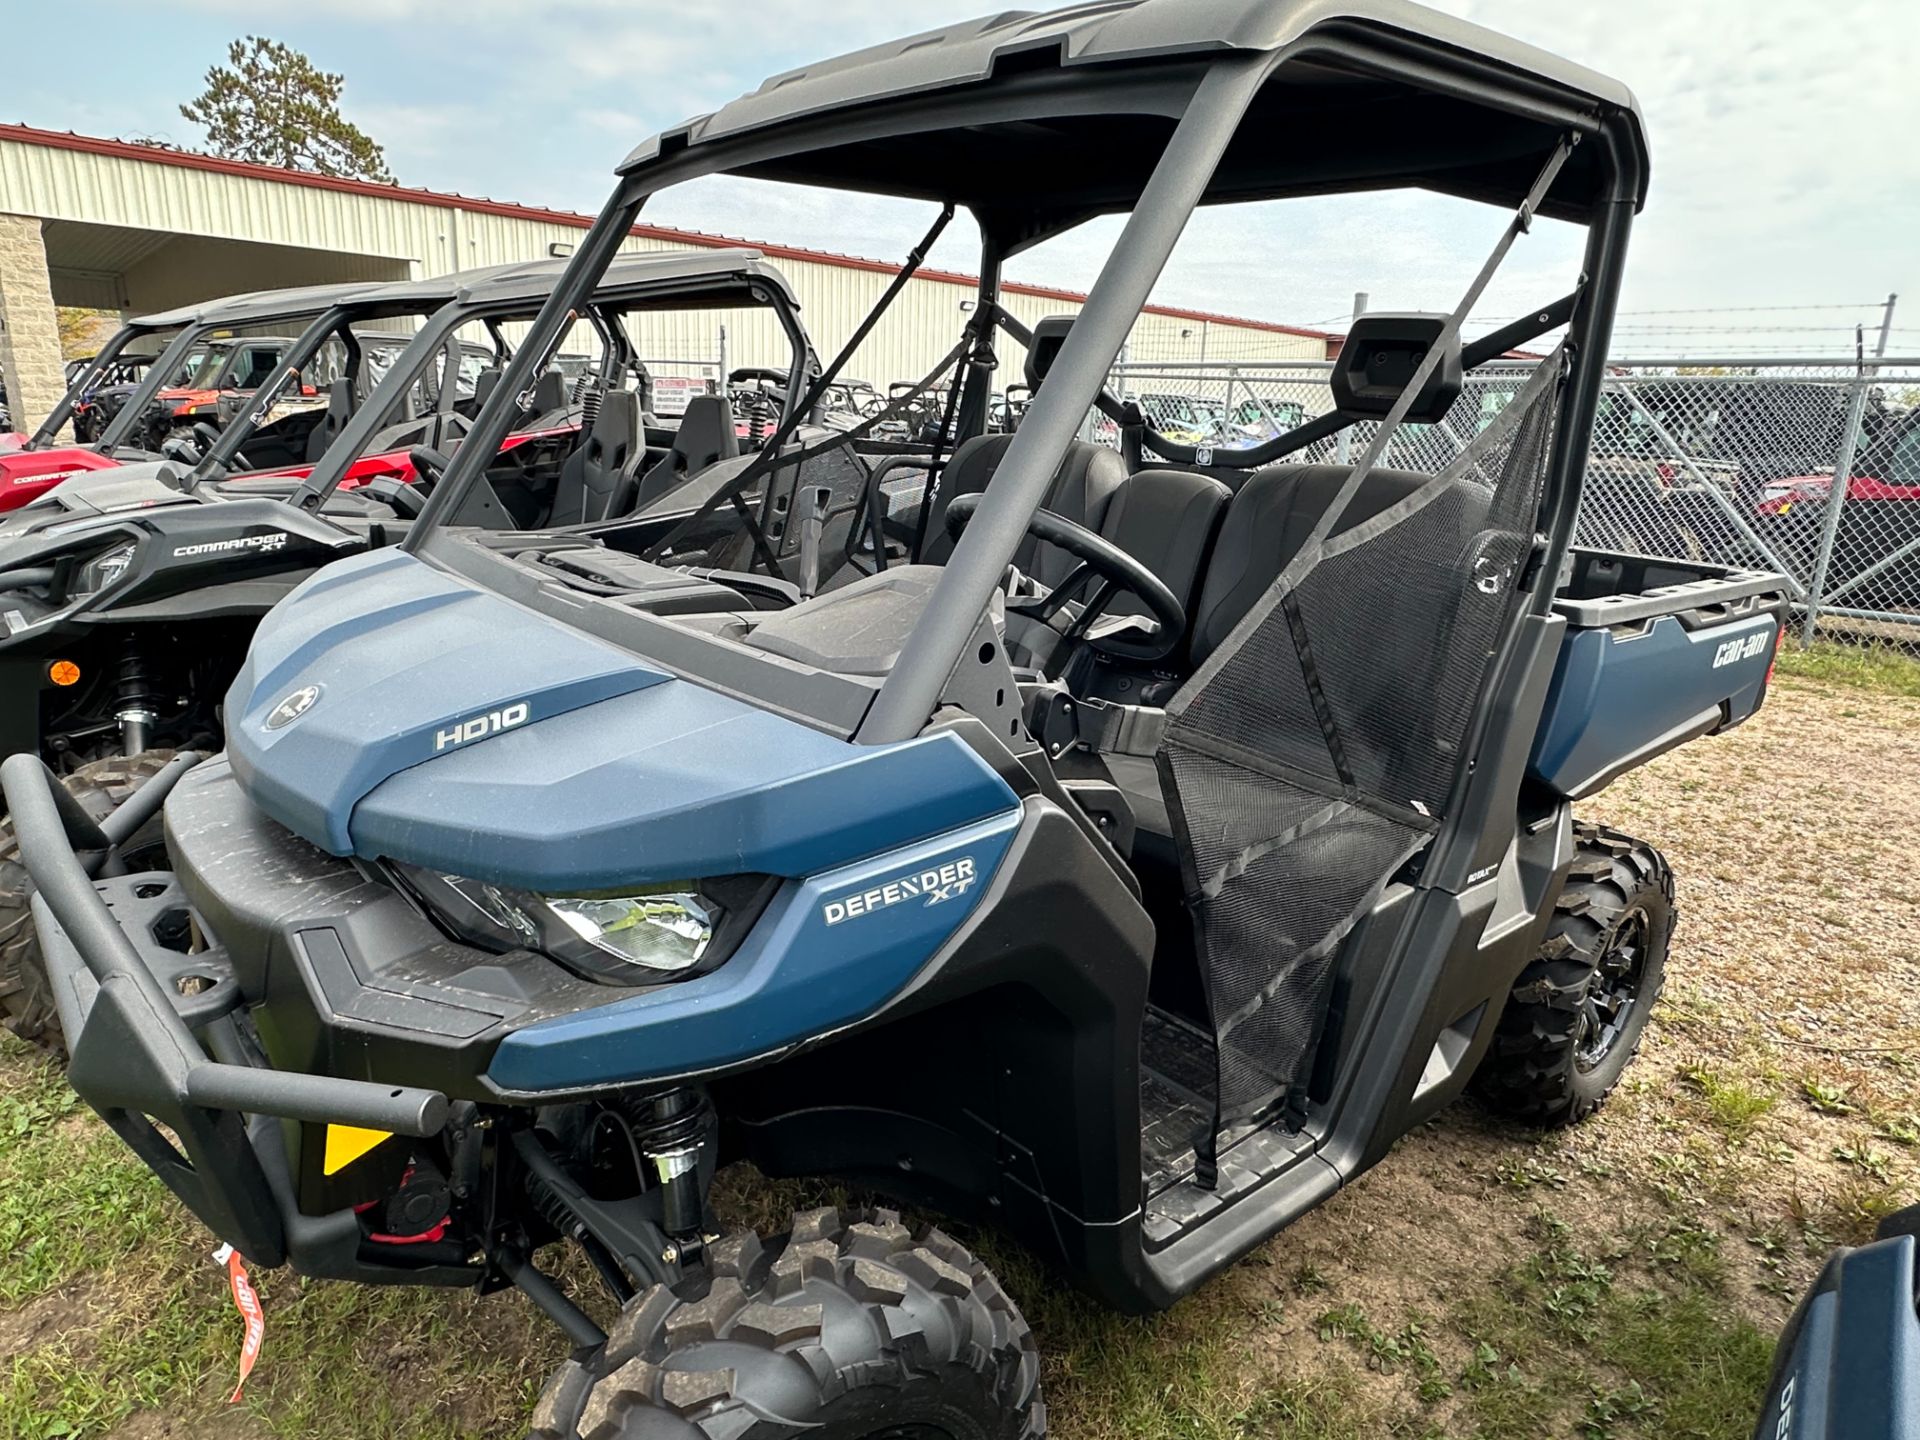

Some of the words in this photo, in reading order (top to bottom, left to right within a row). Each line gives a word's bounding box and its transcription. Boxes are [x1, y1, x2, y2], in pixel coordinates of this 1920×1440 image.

[173, 533, 287, 556] COMMANDER
[259, 541, 286, 551] XT
[1712, 631, 1769, 669] can-am
[436, 703, 528, 750] HD10
[824, 858, 974, 924] DEFENDER
[927, 876, 974, 905] XT
[1775, 1376, 1795, 1440] DE
